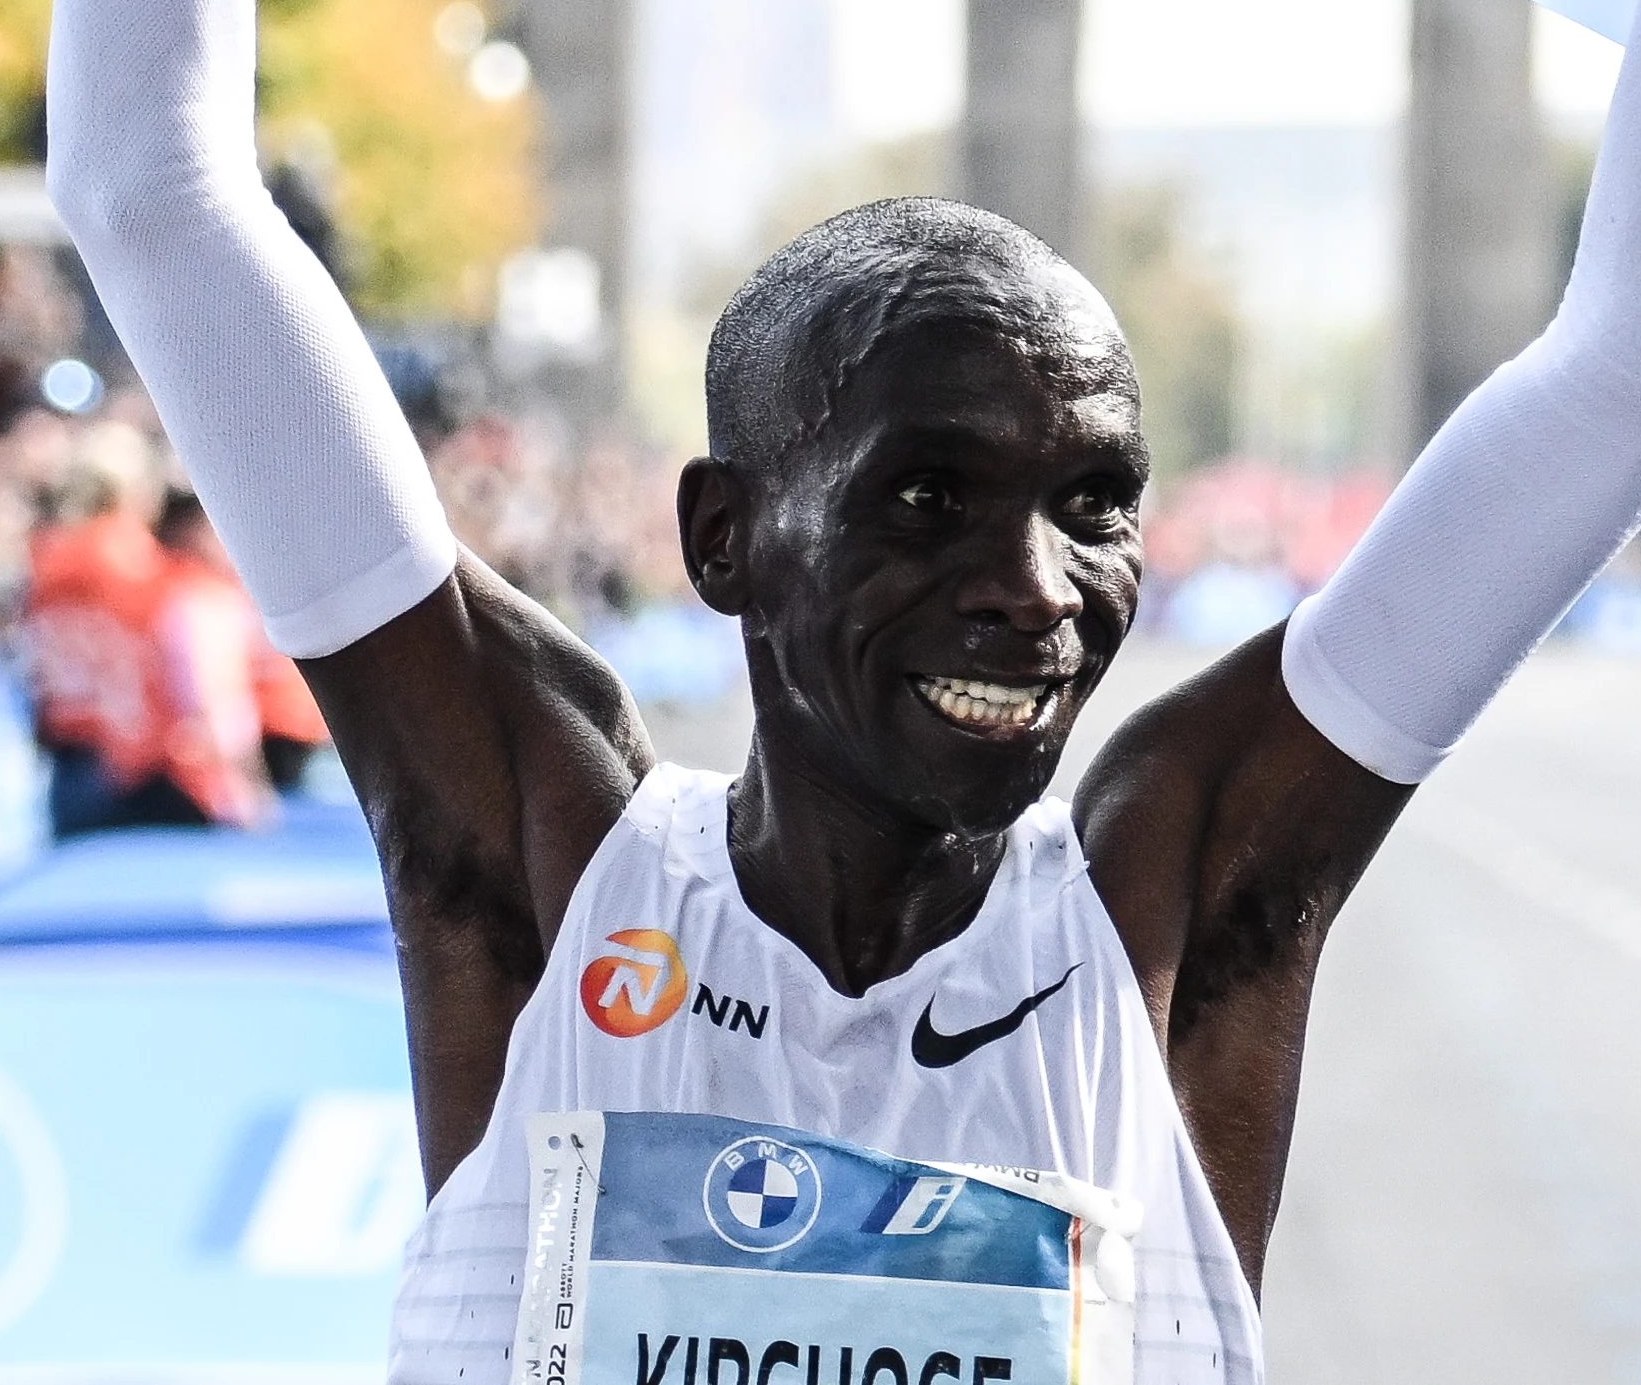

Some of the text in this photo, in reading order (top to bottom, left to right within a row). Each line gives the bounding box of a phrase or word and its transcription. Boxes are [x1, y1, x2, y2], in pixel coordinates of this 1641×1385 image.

[691, 982, 770, 1040] NN
[723, 1141, 810, 1177] BMW
[566, 1166, 584, 1298] WORLD MARATHON MAJORS
